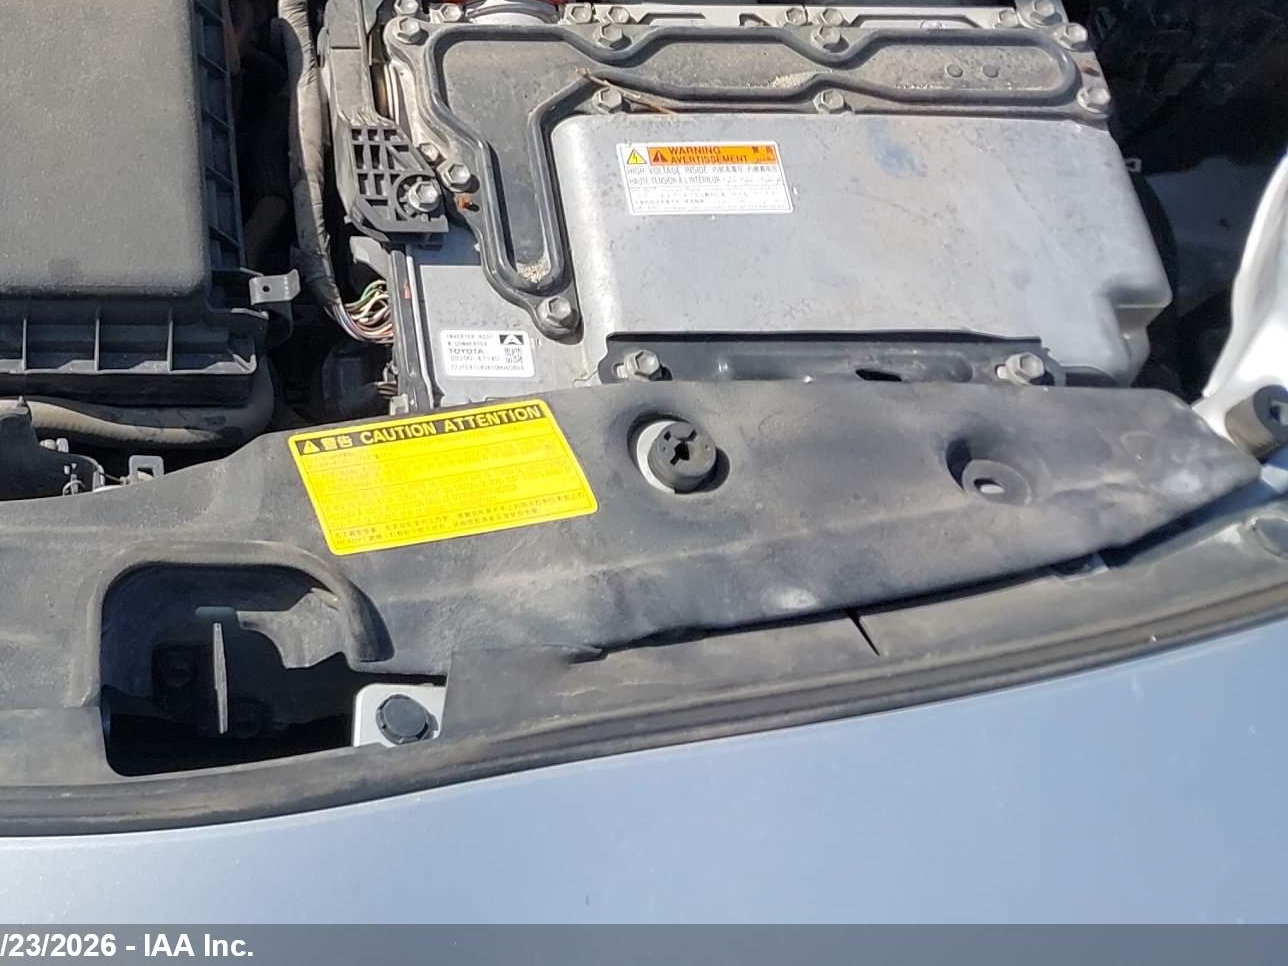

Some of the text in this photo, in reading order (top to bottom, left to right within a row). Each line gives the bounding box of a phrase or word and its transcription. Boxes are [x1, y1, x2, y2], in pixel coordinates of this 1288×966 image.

[668, 146, 721, 154] WARNING
[671, 155, 748, 164] AVERTISSEMENT
[321, 405, 542, 451] 警告 CAUTION ATTENTION
